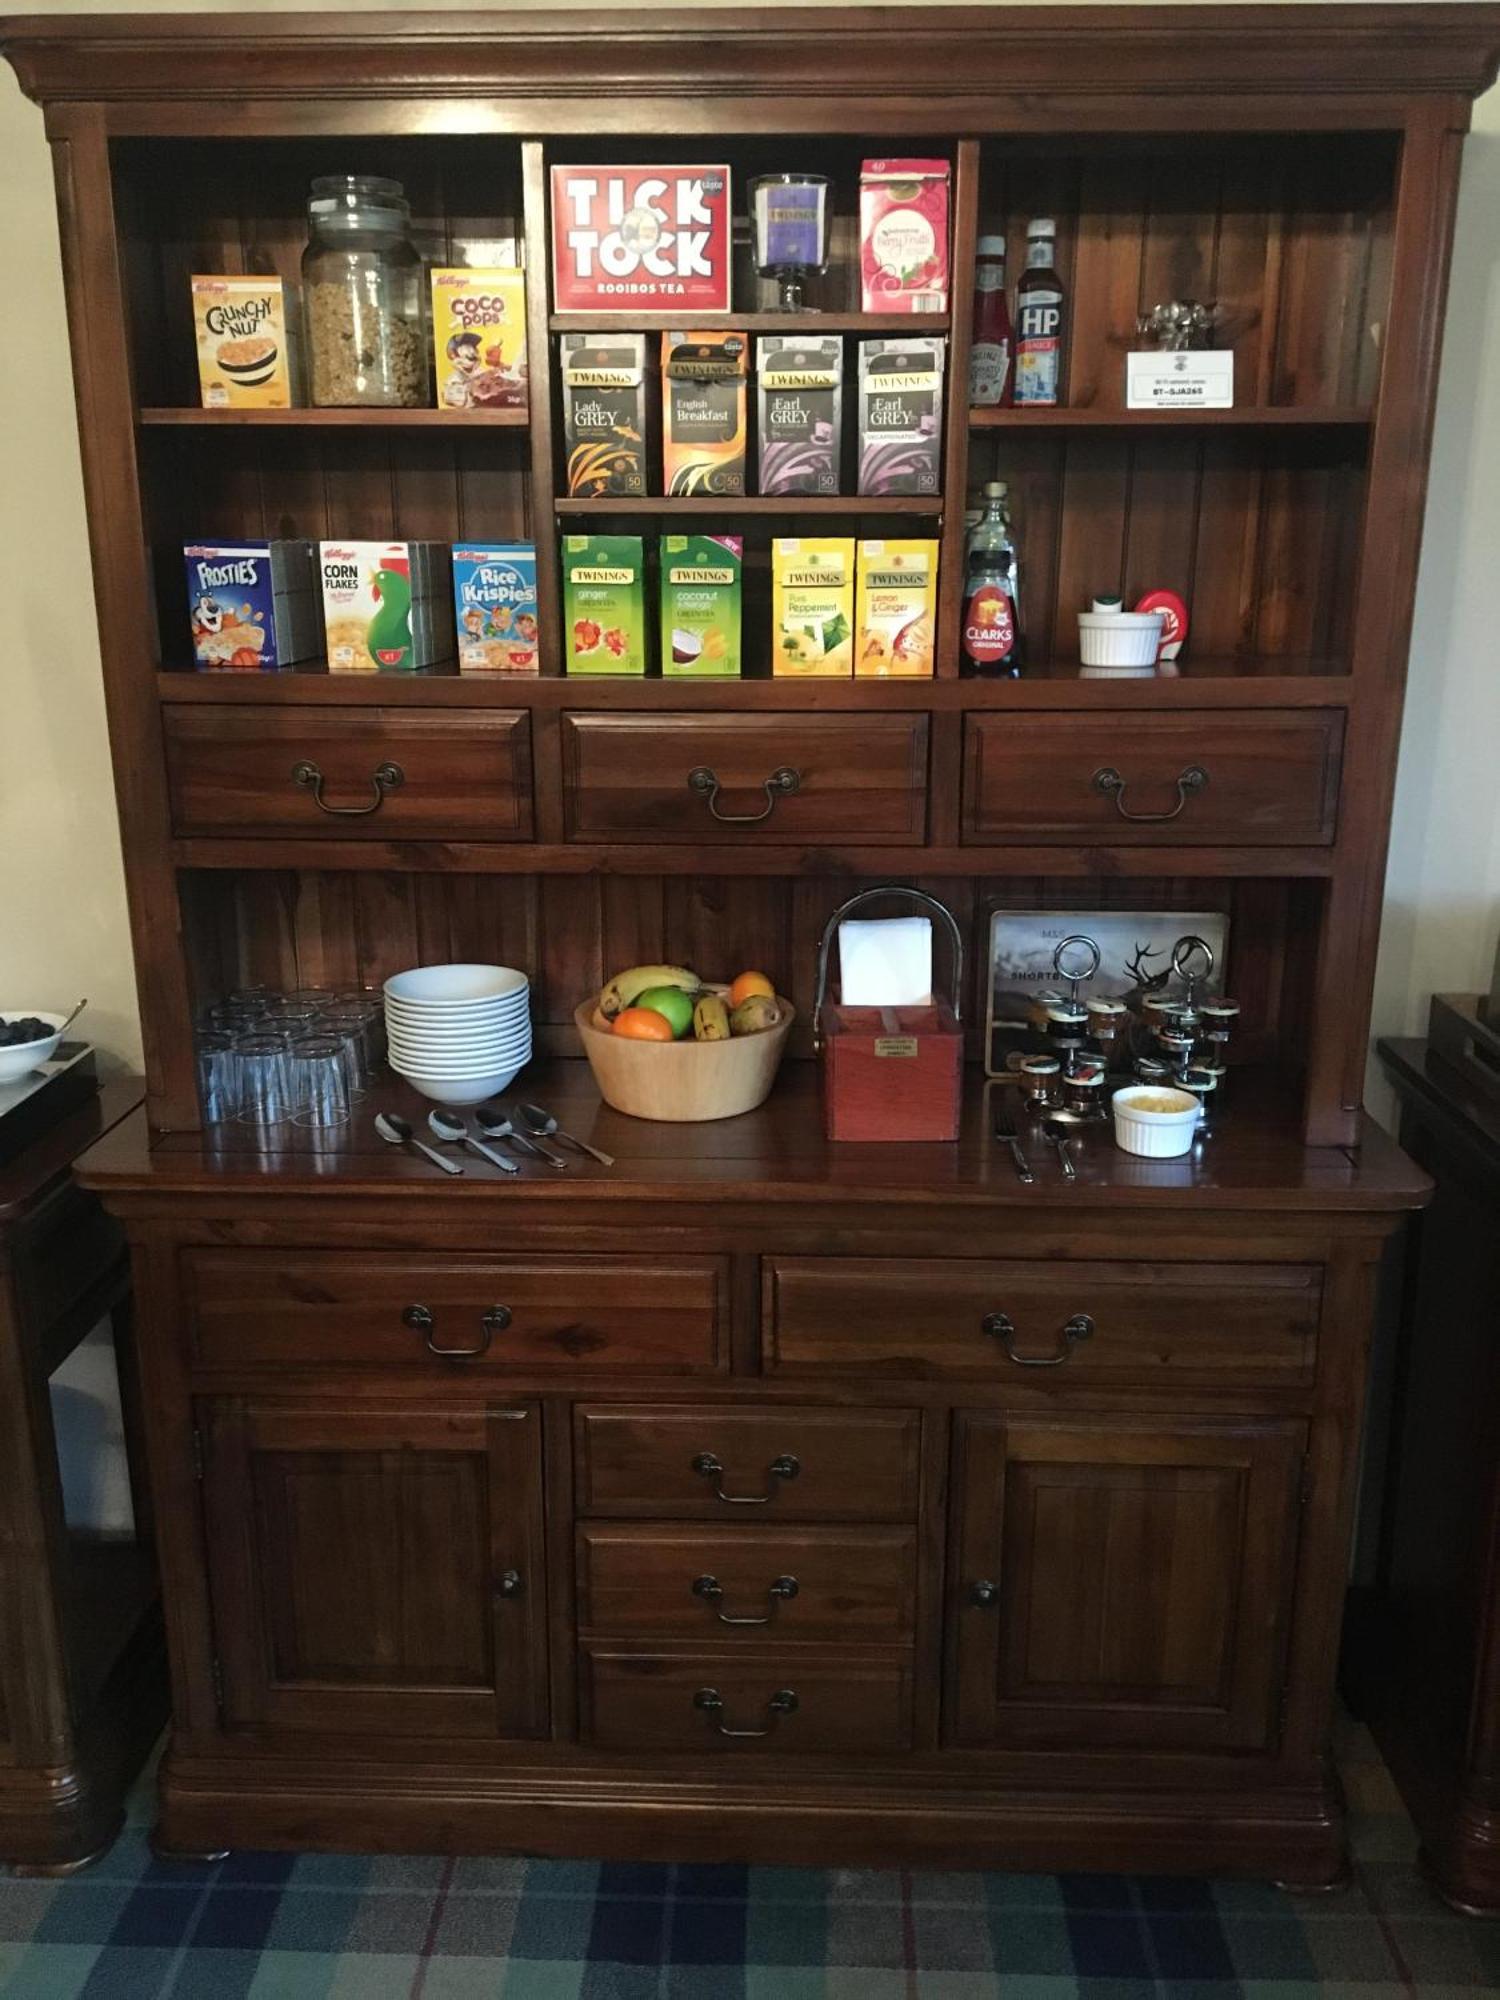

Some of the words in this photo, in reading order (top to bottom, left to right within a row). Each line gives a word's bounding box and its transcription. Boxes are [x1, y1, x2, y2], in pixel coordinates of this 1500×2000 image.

[567, 179, 712, 225] TICK
[568, 231, 712, 277] TOCK
[597, 283, 656, 294] ROOIBOS
[659, 283, 685, 294] TEA
[451, 296, 505, 316] COCO
[206, 297, 272, 335] CRUNCHY
[1021, 308, 1060, 335] HP
[229, 319, 261, 338] NUT
[674, 365, 735, 376] TWININGS
[573, 372, 632, 383] TWININGS
[770, 375, 833, 385] TWININGS
[873, 375, 932, 389] TWININGS
[575, 401, 602, 413] Lady
[677, 400, 708, 411] English
[775, 397, 800, 410] Earl
[875, 397, 902, 411] Earl
[575, 412, 618, 426] GREY
[677, 410, 728, 422] Breakfast
[770, 410, 810, 424] GREY
[870, 411, 912, 425] GREY
[628, 477, 641, 487] 50
[726, 477, 740, 486] 50
[821, 476, 834, 486] 50
[920, 477, 934, 486] 50
[324, 544, 356, 560] Kellogg's
[197, 559, 258, 590] FROSTIES
[324, 565, 358, 578] CORN
[480, 568, 517, 585] Rice
[576, 571, 628, 581] TWININGS
[676, 571, 728, 581] TWININGS
[325, 579, 359, 589] FLAKES
[788, 573, 840, 583] TWININGS
[872, 575, 924, 585] TWININGS
[463, 585, 535, 602] Krispies
[577, 590, 608, 600] ginger
[676, 592, 718, 601] coconut
[788, 603, 837, 613] Peppermint
[878, 602, 908, 613] Ginger
[966, 626, 1012, 641] CLARKS
[972, 641, 1005, 649] ORIGINAL
